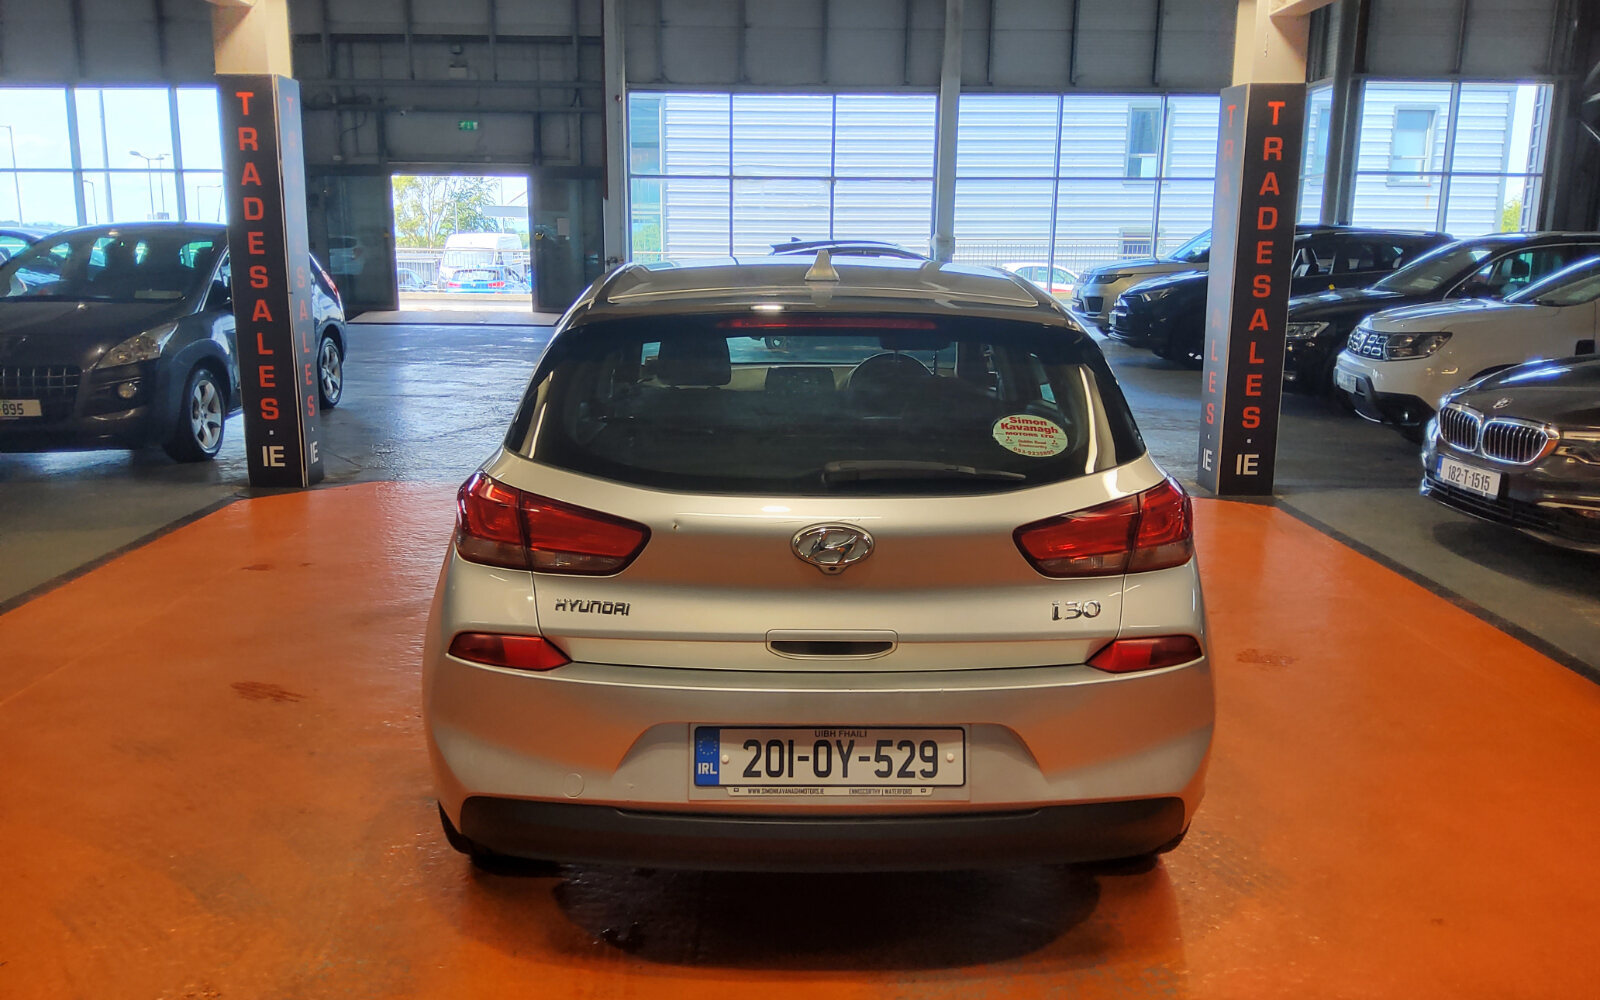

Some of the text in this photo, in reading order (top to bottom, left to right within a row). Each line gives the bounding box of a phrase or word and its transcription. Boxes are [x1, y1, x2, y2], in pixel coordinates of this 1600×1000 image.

[1000, 422, 1058, 434] Kavanagh
[1008, 416, 1048, 426] Simon
[555, 598, 631, 616] HYUNDAI
[1052, 599, 1101, 621] i30
[814, 729, 836, 738] UIBH
[698, 739, 939, 778] IRL 201-OY-529
